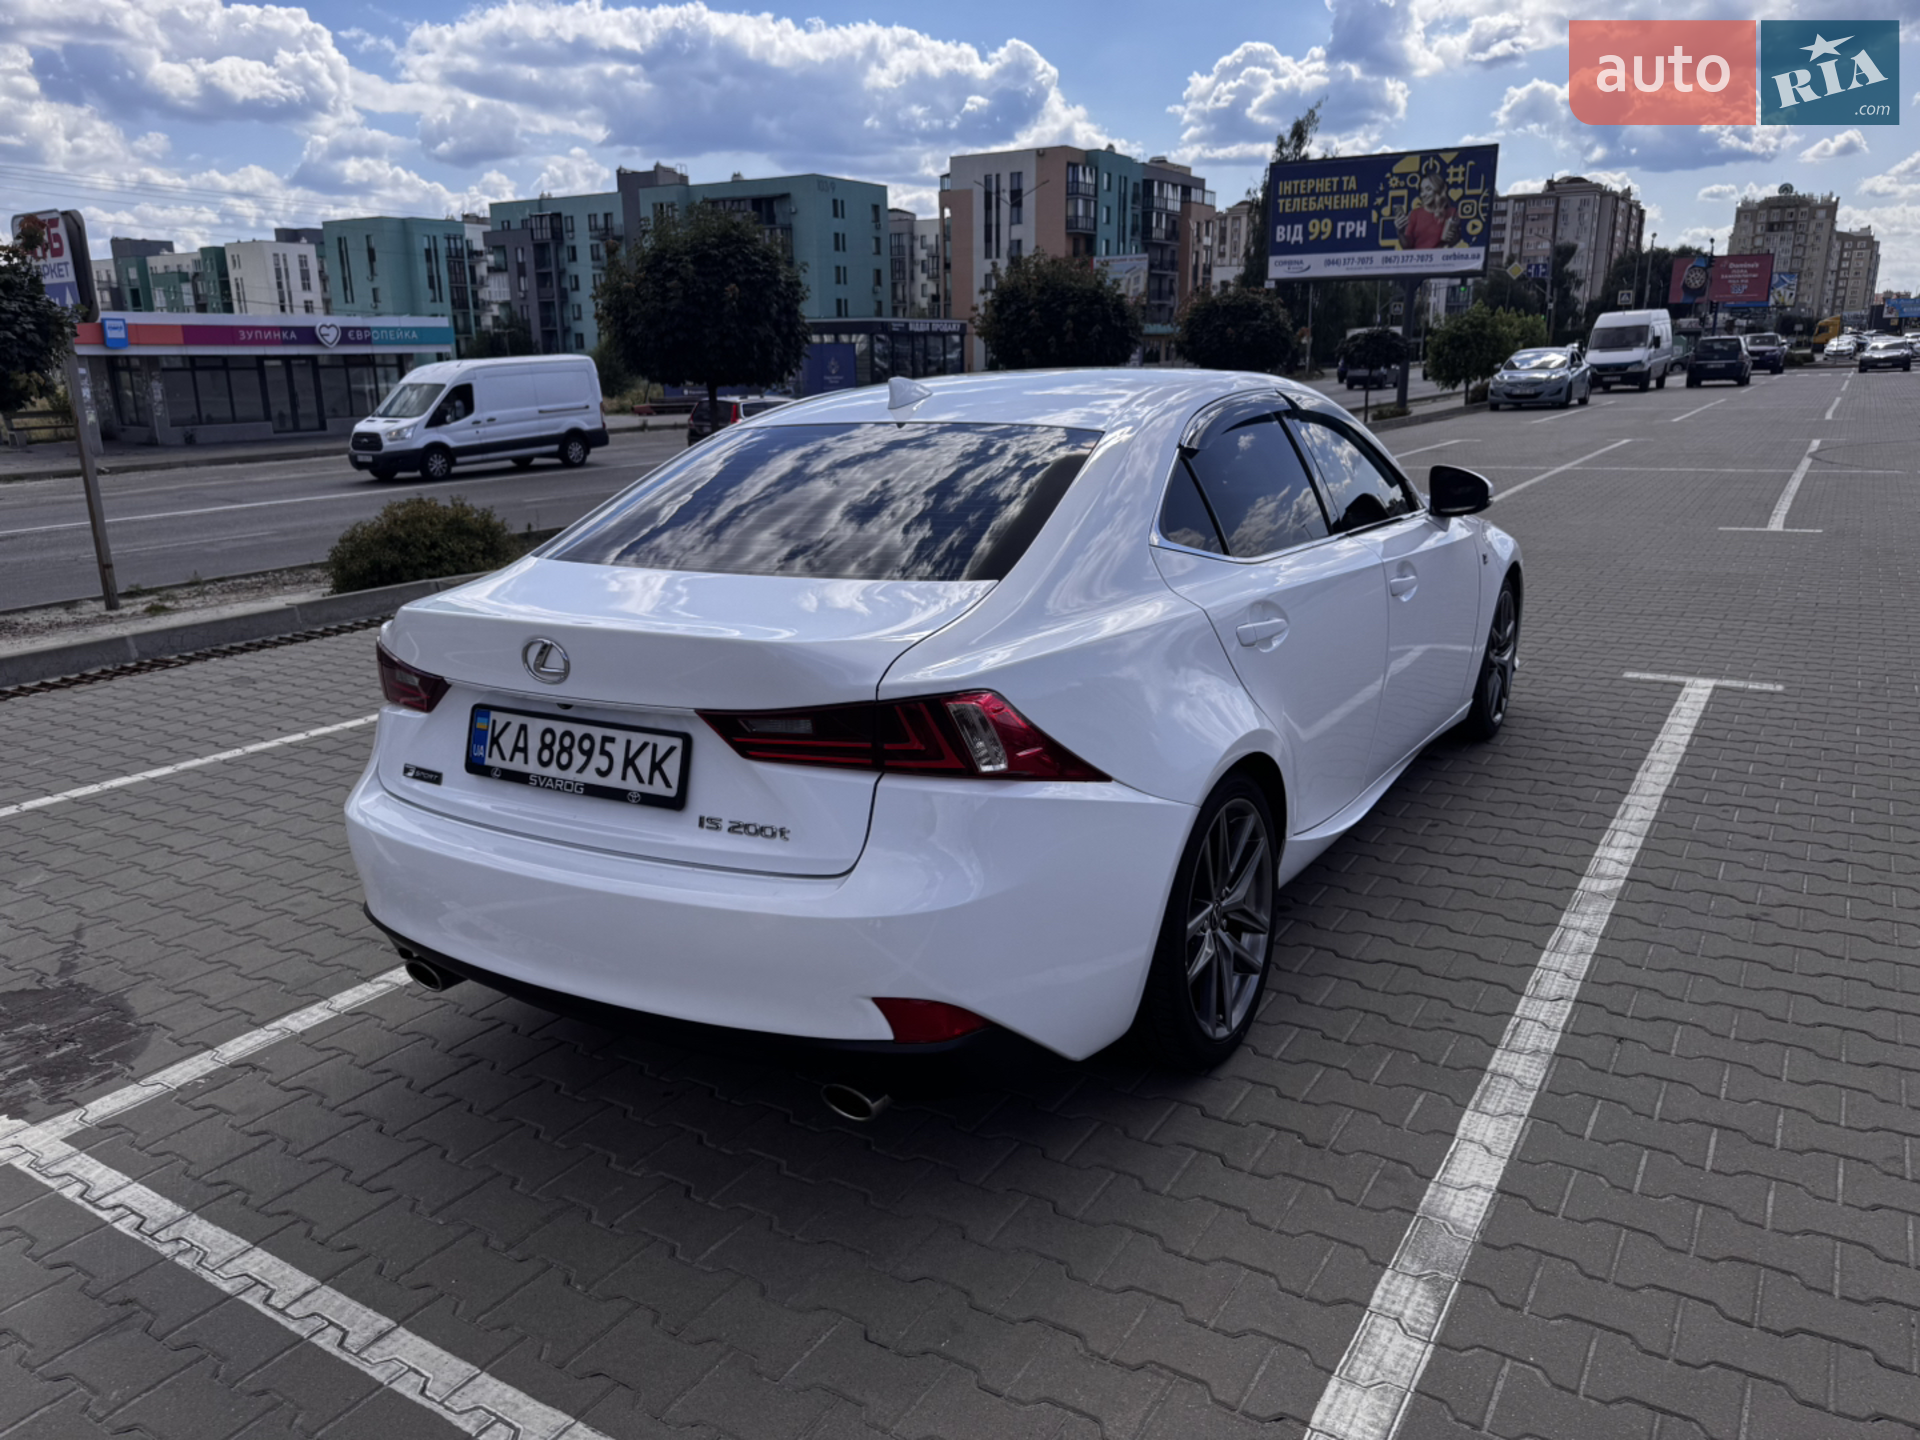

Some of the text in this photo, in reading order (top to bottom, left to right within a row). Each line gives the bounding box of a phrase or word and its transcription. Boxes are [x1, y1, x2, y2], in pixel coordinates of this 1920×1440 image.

[1279, 175, 1357, 195] ІНТЕРНЕТ ТА
[1277, 192, 1369, 213] ТЕЛЕБАЧЕННЯ
[1276, 218, 1367, 245] ВІД 99 ГРН
[1441, 252, 1481, 261] corbina.ua
[239, 329, 418, 341] ЗУПИНКА ЄВРОПЕЙКА
[473, 744, 485, 757] UA
[488, 719, 677, 789] KA 8895 KK
[415, 770, 439, 782] SPORT
[528, 774, 585, 794] SVAROG
[698, 815, 791, 842] IS 200t
